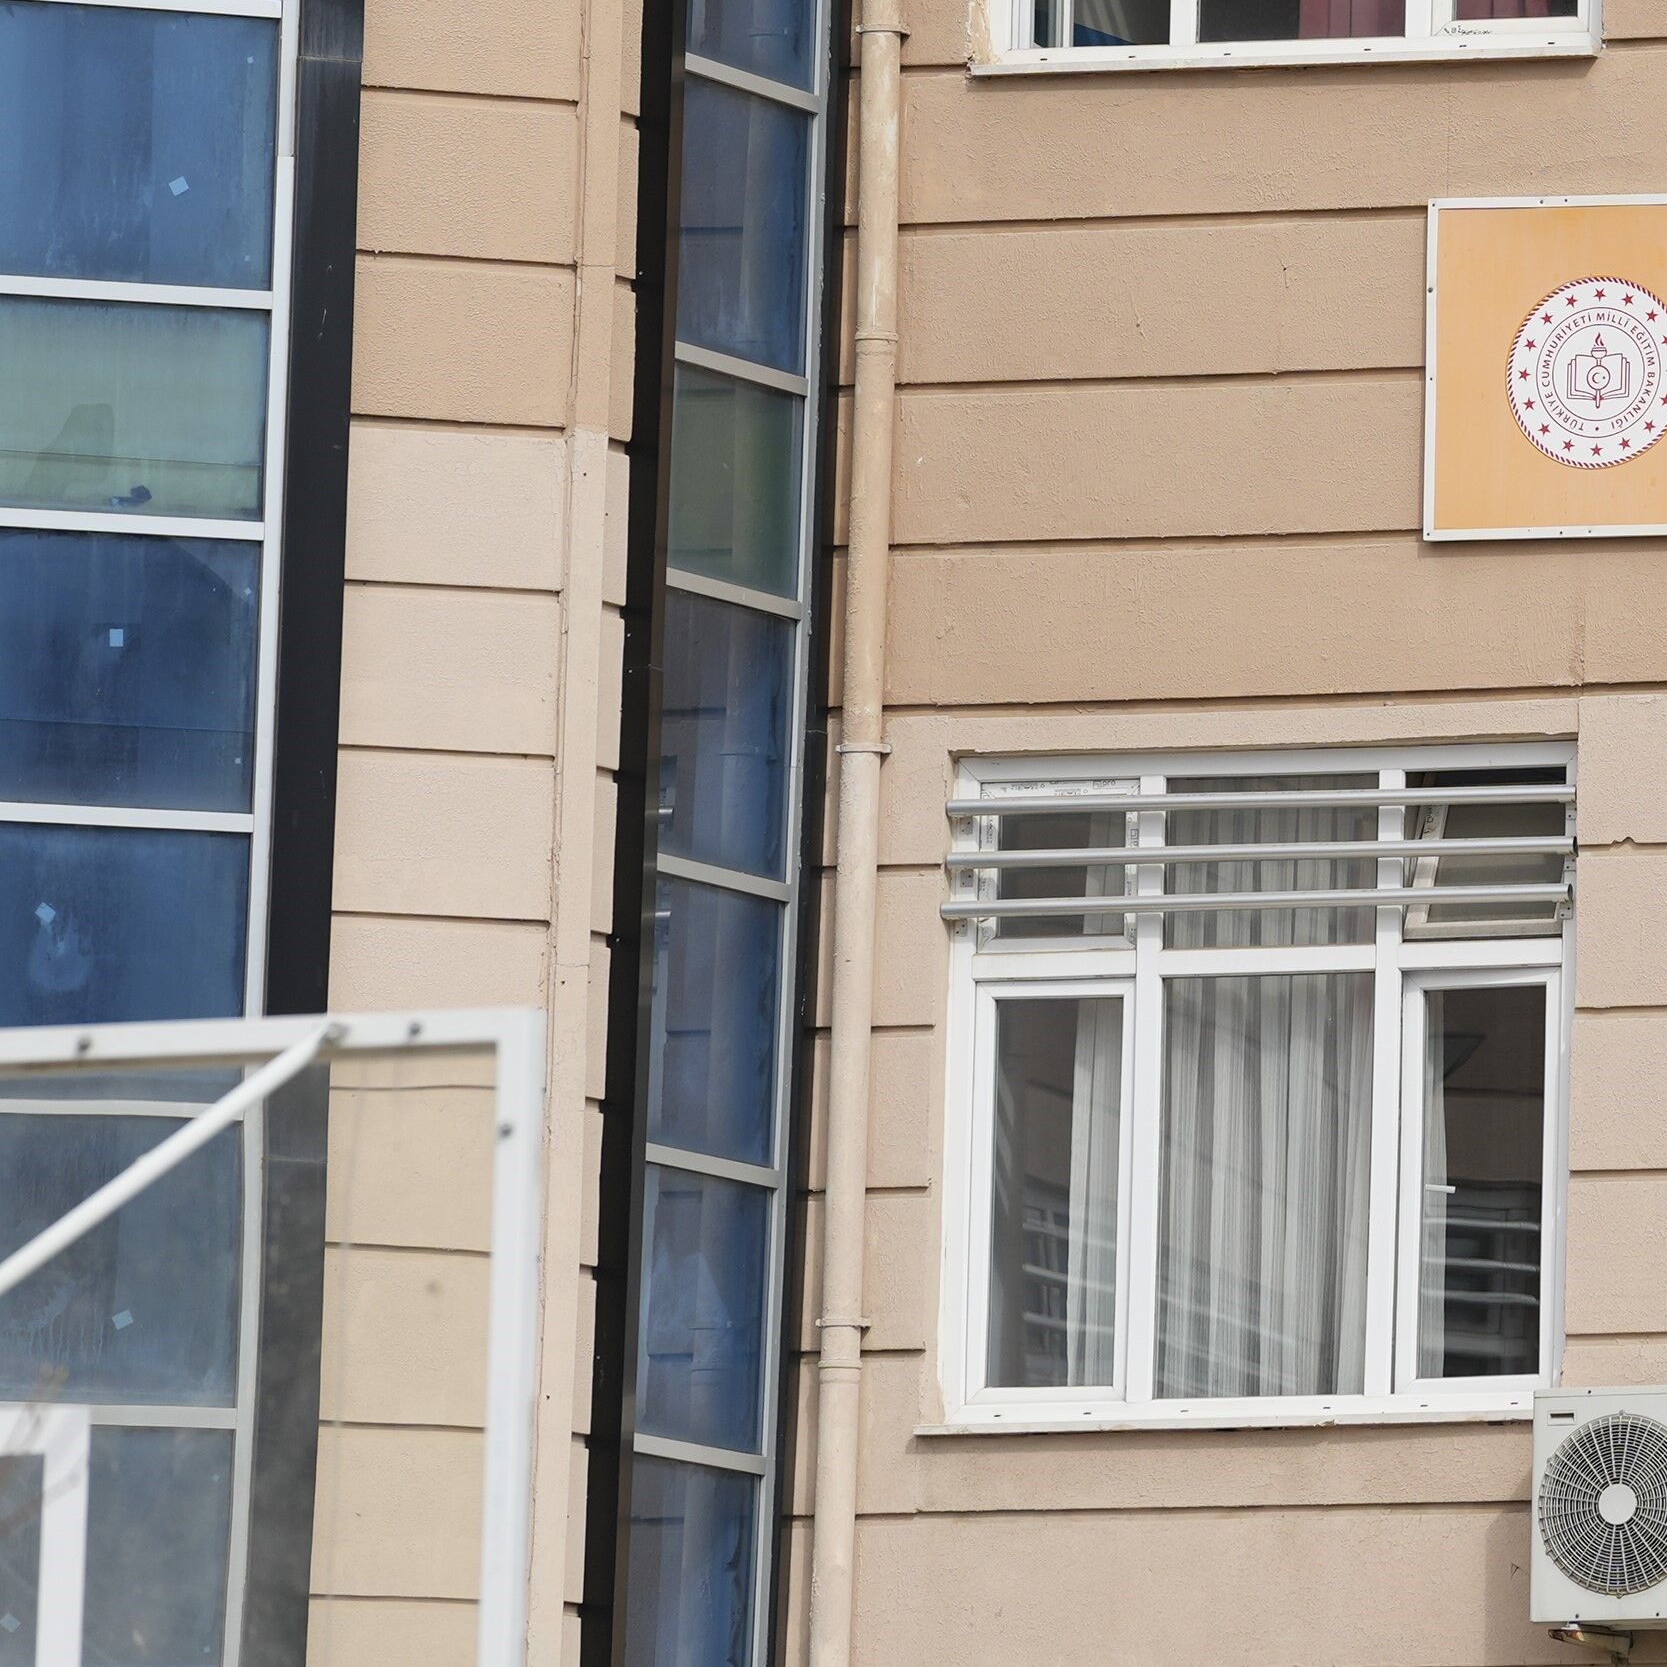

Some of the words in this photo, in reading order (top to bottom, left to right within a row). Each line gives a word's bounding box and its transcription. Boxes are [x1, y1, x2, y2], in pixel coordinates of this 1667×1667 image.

[1595, 310, 1631, 328] MİLLİ
[1541, 312, 1593, 389] CUMHURİYETİ
[1631, 325, 1655, 367] EĞİTİM
[1544, 391, 1585, 432] TÜRKİYE
